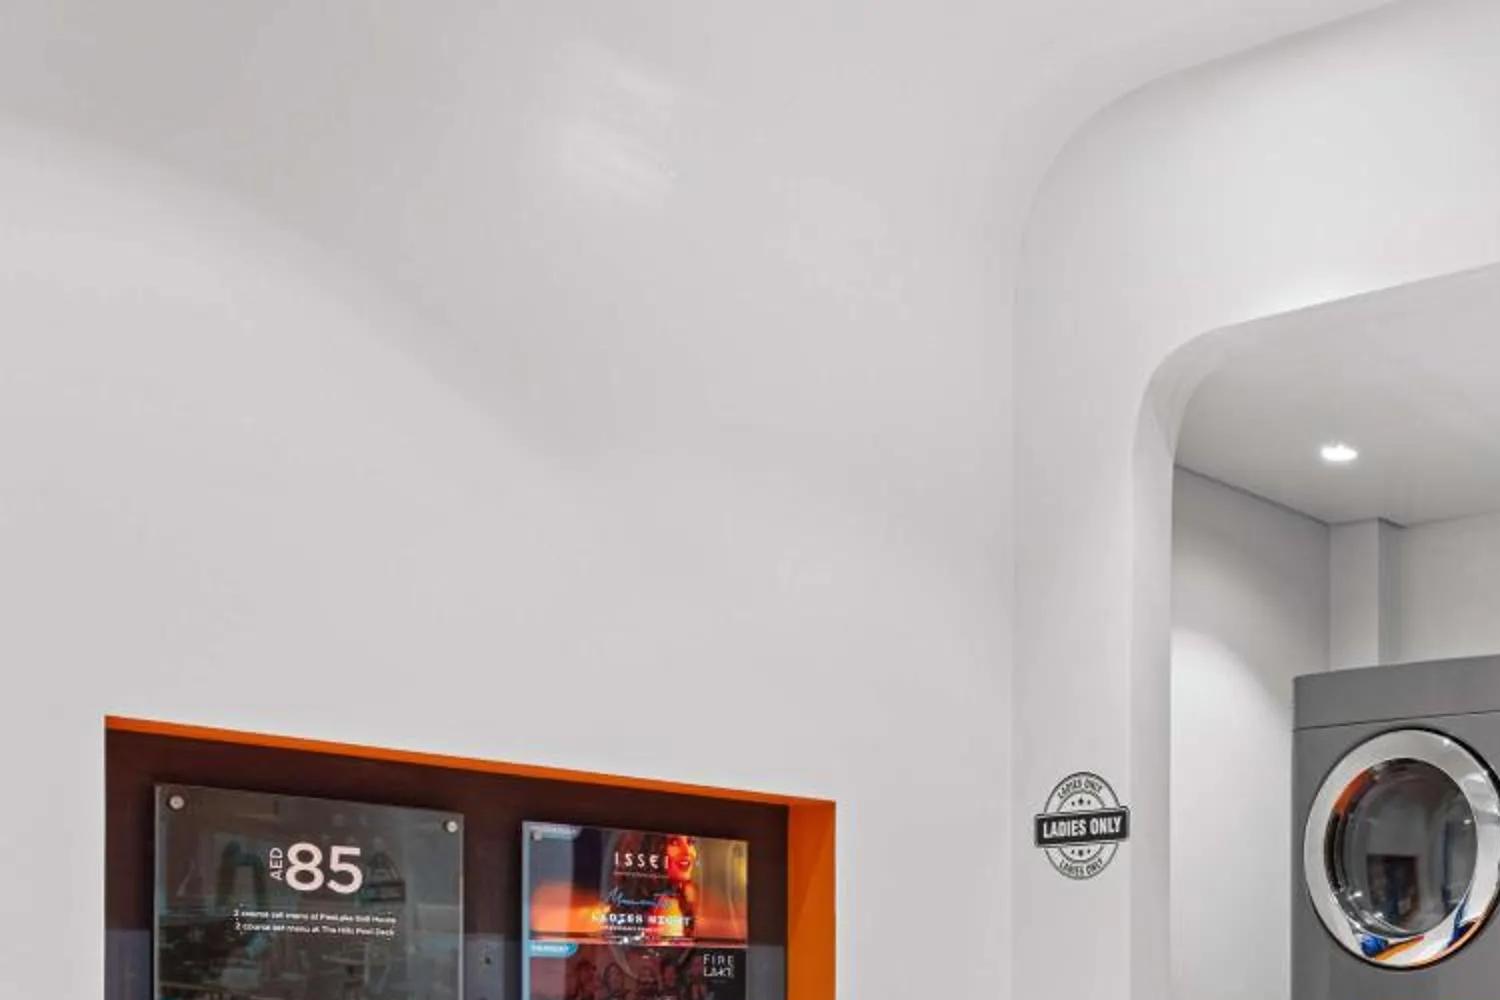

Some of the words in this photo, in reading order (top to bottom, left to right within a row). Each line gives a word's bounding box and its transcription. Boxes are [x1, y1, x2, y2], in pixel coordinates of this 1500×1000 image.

[1057, 779, 1082, 799] LADIES
[1084, 779, 1102, 792] ONLY
[1043, 819, 1087, 838] LADIES
[1090, 815, 1122, 835] ONLY
[269, 848, 283, 881] AED
[286, 843, 363, 894] 85
[1060, 859, 1084, 874] LADIES
[1086, 857, 1103, 875] ONLY
[242, 923, 271, 931] course
[287, 924, 310, 933] menu
[703, 953, 734, 966] FIRE
[703, 966, 735, 978] LAKE
